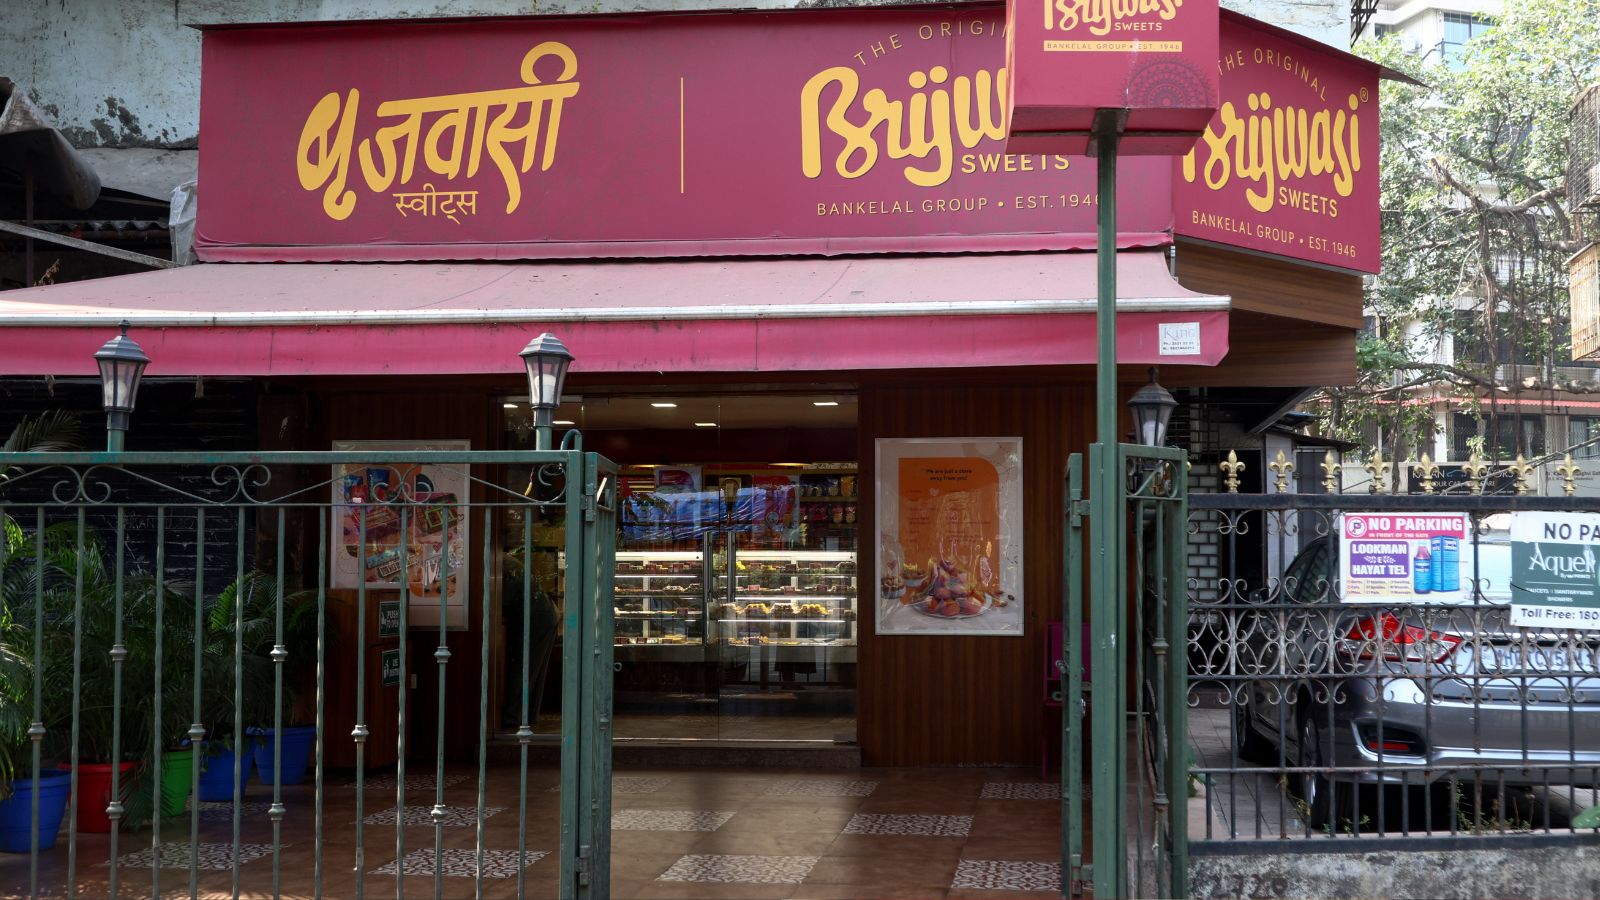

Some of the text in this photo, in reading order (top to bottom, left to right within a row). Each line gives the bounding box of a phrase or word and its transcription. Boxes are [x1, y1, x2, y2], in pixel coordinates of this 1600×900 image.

[1044, 0, 1183, 36] Brijw
[1114, 22, 1163, 31] SWEETS
[854, 20, 1006, 66] THE ORIGI
[1254, 48, 1327, 102] ORIGINAL
[801, 66, 1006, 187] Brijw
[393, 183, 479, 224] स्वीट्स
[816, 199, 915, 217] BANKELAL
[922, 197, 988, 213] GROUP
[1015, 195, 1054, 209] EST.
[1279, 186, 1338, 218] SWEETS
[1192, 210, 1356, 259] BANKELAL GROUP EST. 1946
[1368, 517, 1463, 531] NO PARKING
[1544, 523, 1572, 540] NO
[1352, 543, 1407, 555] LOOKMAN
[1352, 564, 1386, 575] HAYAT
[1388, 564, 1408, 575] TEL
[1521, 608, 1542, 618] Toll
[1545, 609, 1576, 619] Free:
